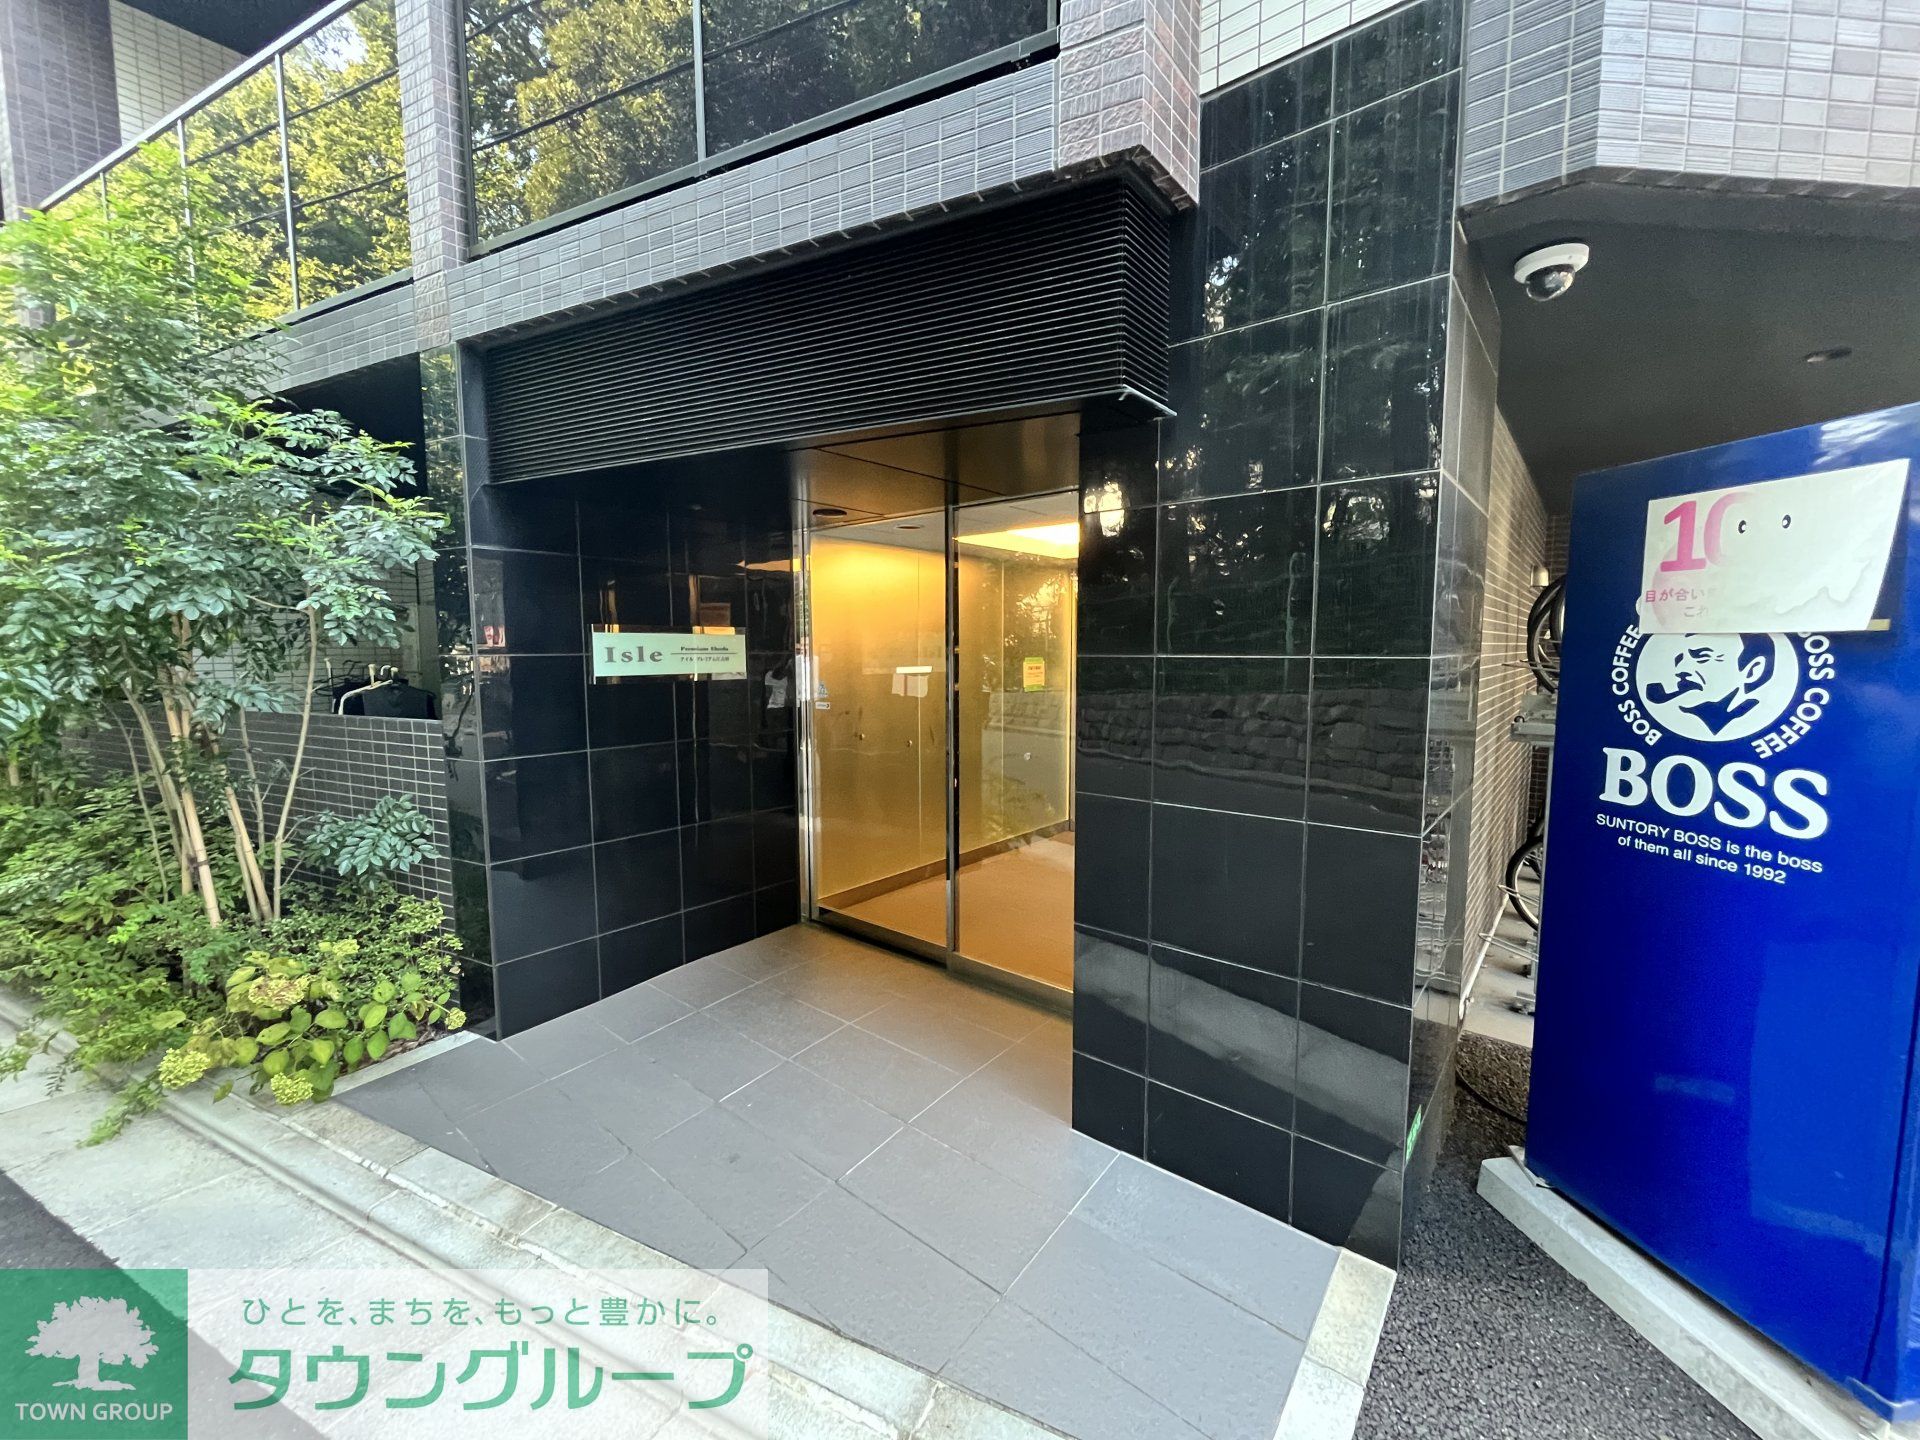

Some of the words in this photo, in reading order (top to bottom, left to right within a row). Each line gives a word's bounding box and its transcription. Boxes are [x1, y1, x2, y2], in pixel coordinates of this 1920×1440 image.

[1645, 587, 1714, 603] 目が合い
[604, 646, 663, 664] Isle
[1611, 624, 1644, 696] COFFEE
[1797, 631, 1835, 681] OSS
[1617, 699, 1663, 746] BOSS
[1751, 687, 1830, 759] COFFEE
[1599, 747, 1828, 840] BOSS
[1596, 813, 1670, 839] SUNTORY
[1673, 829, 1722, 851] BOSS
[1726, 840, 1740, 855] is
[1745, 844, 1772, 862] the
[1777, 850, 1823, 874] boss
[1617, 835, 1632, 847] of
[1634, 839, 1669, 856] them
[1673, 848, 1692, 861] all
[1695, 852, 1738, 873] since
[1743, 863, 1787, 884] 1992
